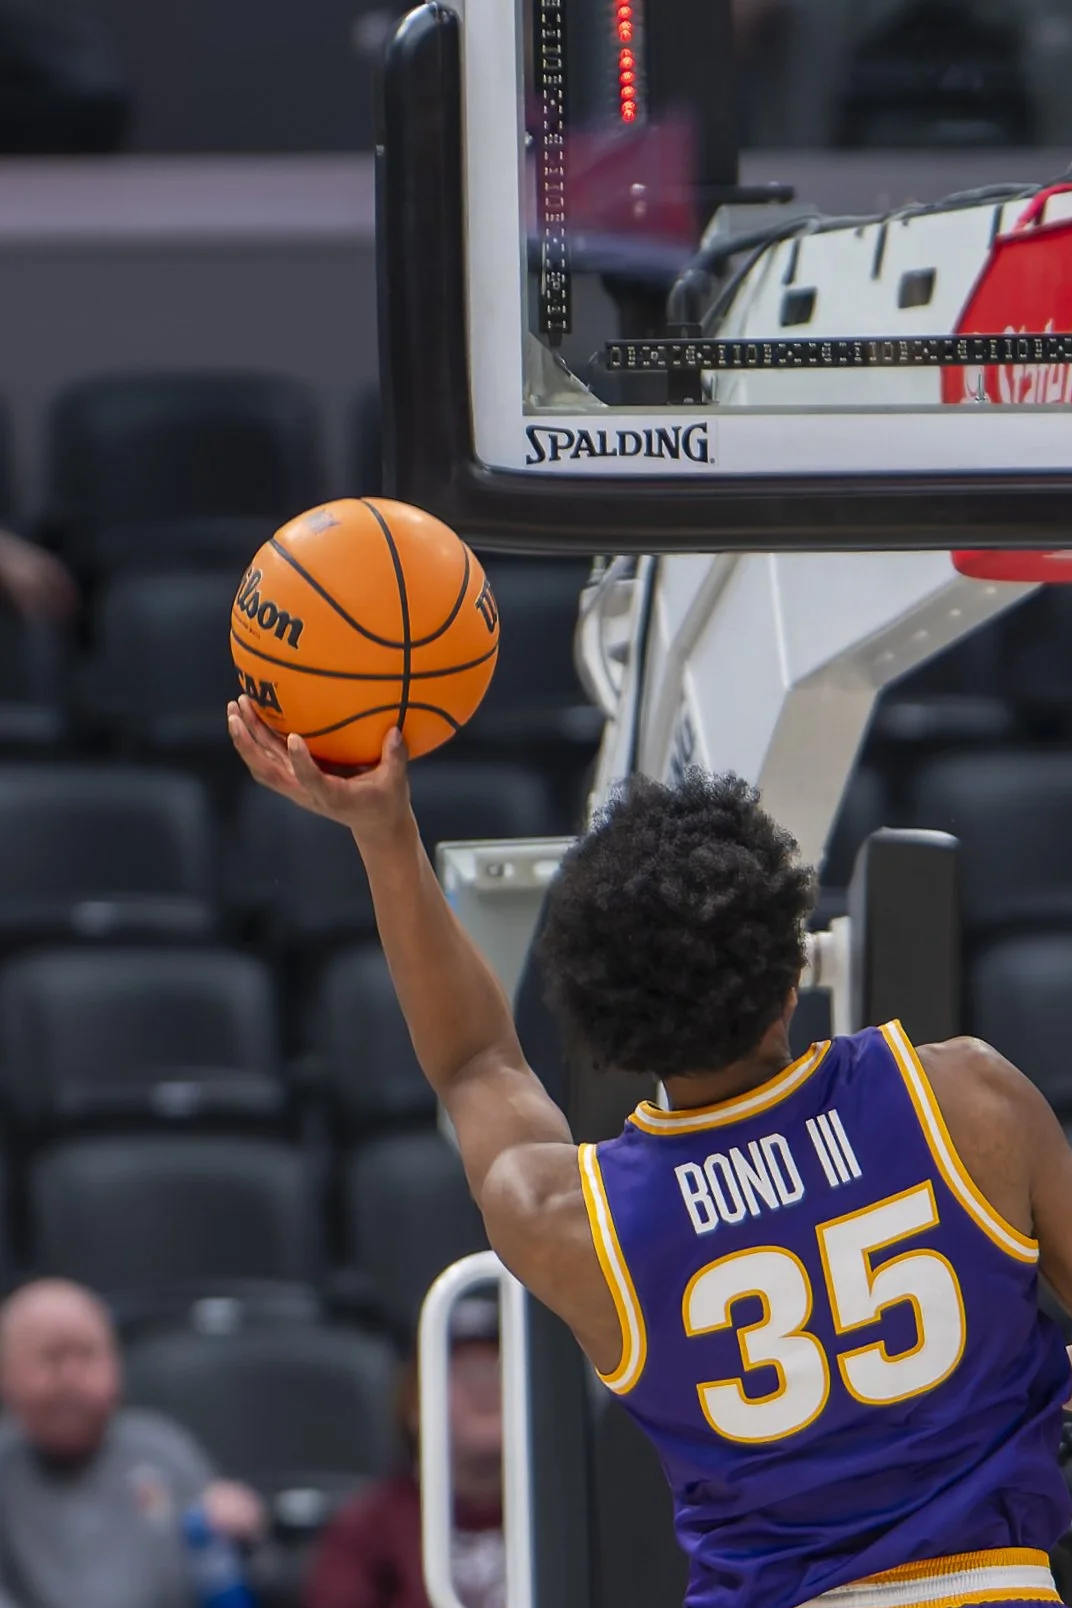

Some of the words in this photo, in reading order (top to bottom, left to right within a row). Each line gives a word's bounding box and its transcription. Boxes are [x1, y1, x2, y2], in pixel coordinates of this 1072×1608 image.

[525, 422, 709, 465] SPALDING
[674, 1132, 805, 1235] BOND
[805, 1109, 862, 1187] III
[681, 1178, 967, 1444] 35
